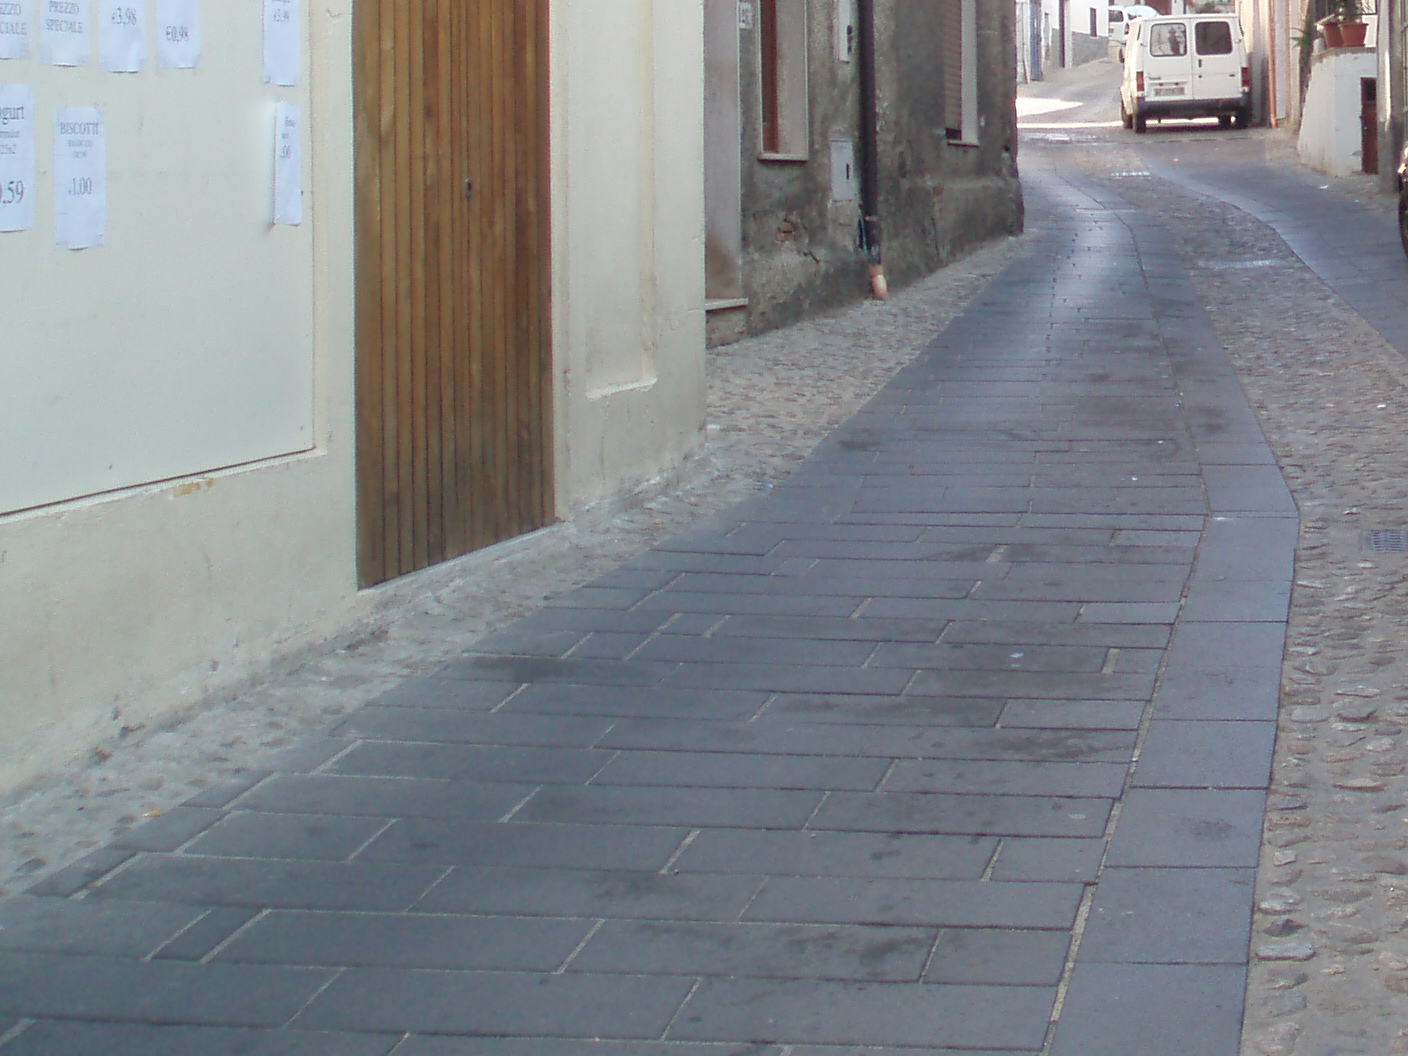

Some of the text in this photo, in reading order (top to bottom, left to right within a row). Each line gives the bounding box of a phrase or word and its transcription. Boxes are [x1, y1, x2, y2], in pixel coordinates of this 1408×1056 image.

[48, 0, 80, 15] PREZZO
[46, 18, 84, 34] SPECIALE
[60, 122, 98, 135] BISCOTTI
